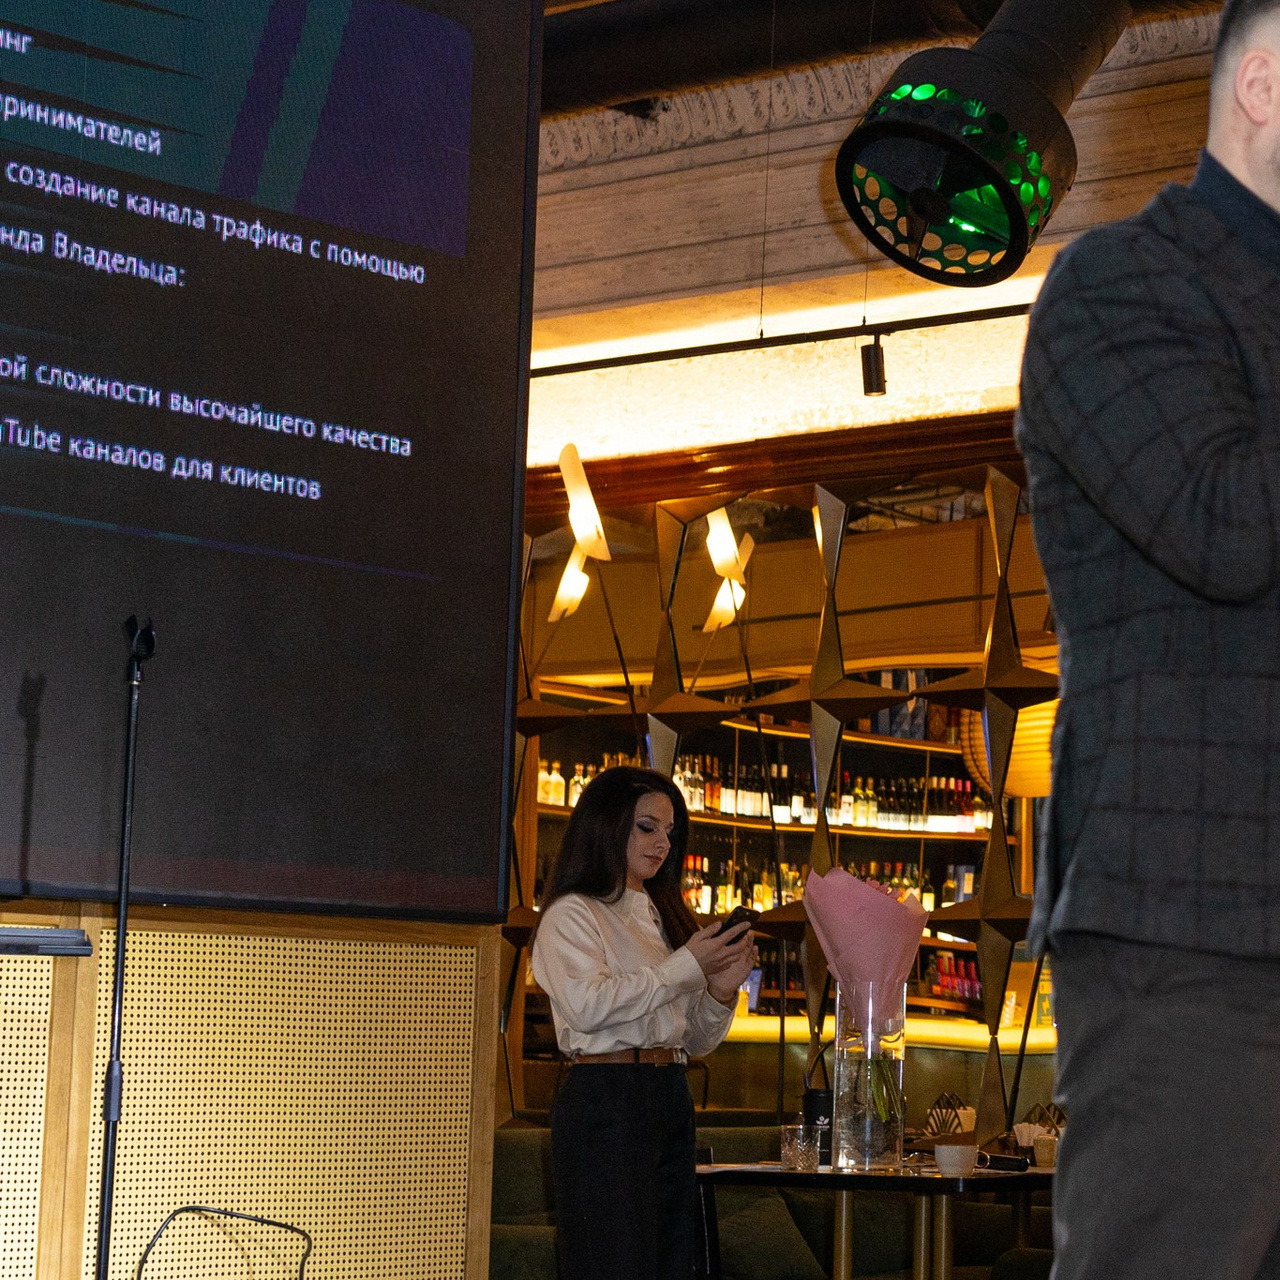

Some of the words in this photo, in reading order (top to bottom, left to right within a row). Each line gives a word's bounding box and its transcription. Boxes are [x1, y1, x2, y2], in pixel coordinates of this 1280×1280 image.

[0, 28, 33, 53] нг
[0, 93, 162, 156] ринимателей
[5, 162, 119, 208] создание
[126, 192, 206, 230] канала
[212, 213, 303, 255] трафика
[309, 239, 321, 259] с
[327, 243, 425, 284] помощью
[53, 230, 186, 287] Владельца:
[35, 364, 162, 408] сложности
[169, 391, 317, 438] высочайшего
[321, 422, 413, 457] качества
[68, 436, 166, 472] каналов
[171, 456, 214, 481] для
[220, 465, 322, 501] клиентов
